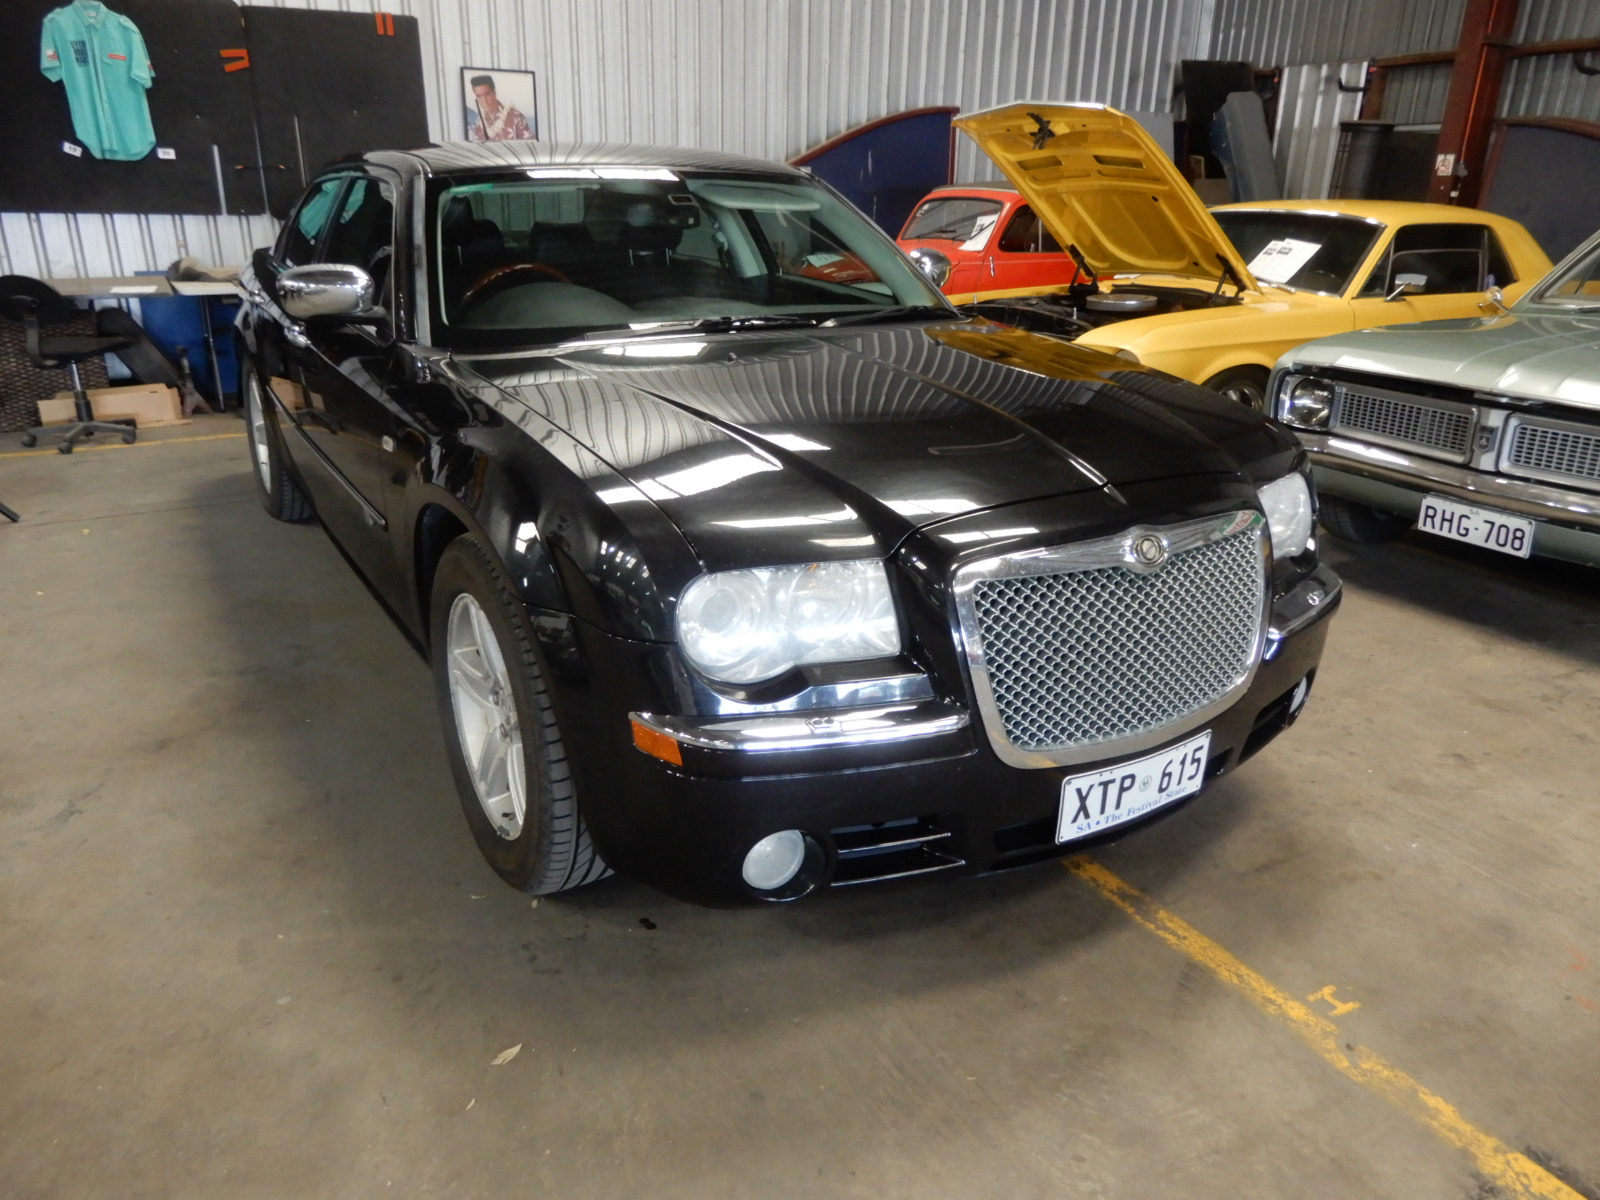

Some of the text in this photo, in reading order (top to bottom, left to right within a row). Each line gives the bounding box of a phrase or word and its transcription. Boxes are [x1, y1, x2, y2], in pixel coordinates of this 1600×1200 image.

[1070, 745, 1204, 824] XTP 615
[1076, 785, 1187, 833] SA The Festival State
